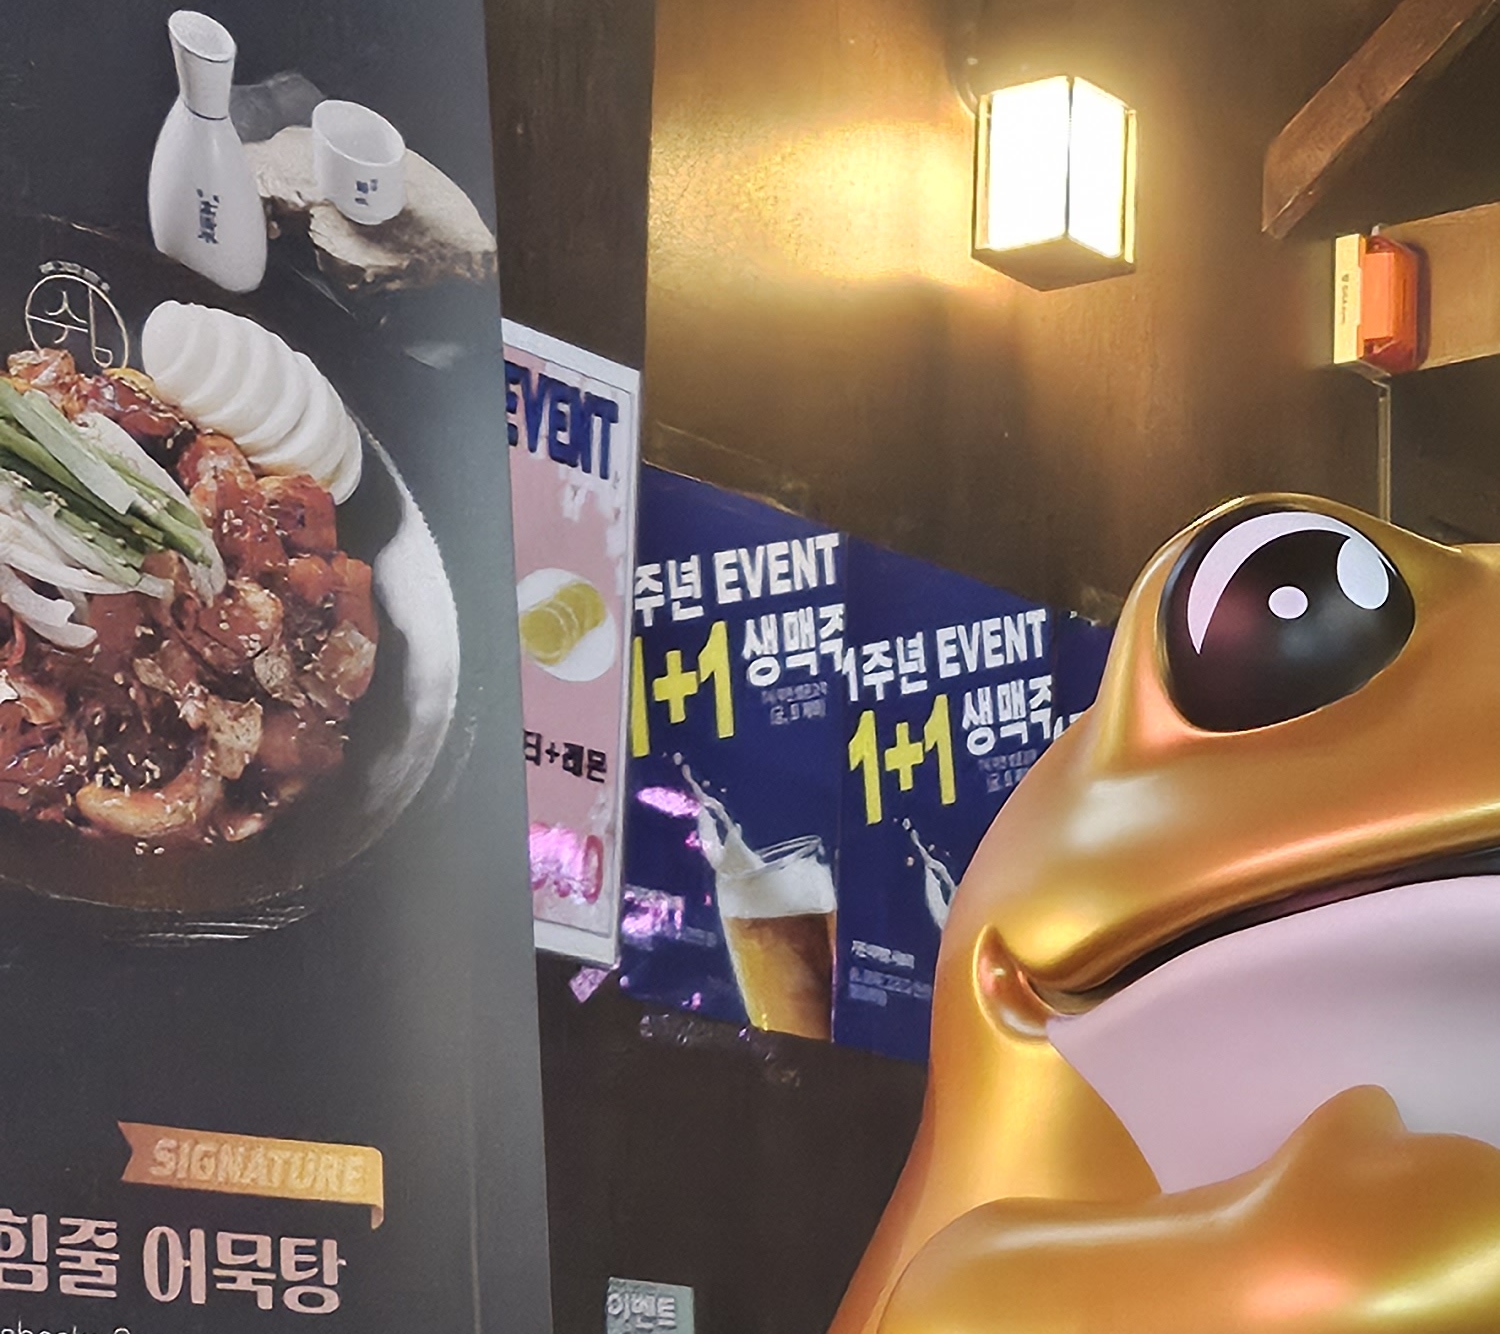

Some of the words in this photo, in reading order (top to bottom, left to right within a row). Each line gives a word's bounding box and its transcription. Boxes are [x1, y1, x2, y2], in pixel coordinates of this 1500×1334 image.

[504, 360, 619, 480] EVENT
[713, 533, 840, 605] EVENT
[631, 620, 735, 758] 1+1
[741, 603, 845, 687] 생맥주
[841, 631, 928, 702] 1주년
[936, 608, 1047, 679] EVENT
[848, 694, 957, 825] 1+1
[962, 675, 1052, 756] 생맥주
[151, 1137, 365, 1193] SIGNATURE
[0, 1207, 121, 1298] 힘줄
[143, 1225, 347, 1314] 어묵탕
[606, 1292, 677, 1330] 이벤트
